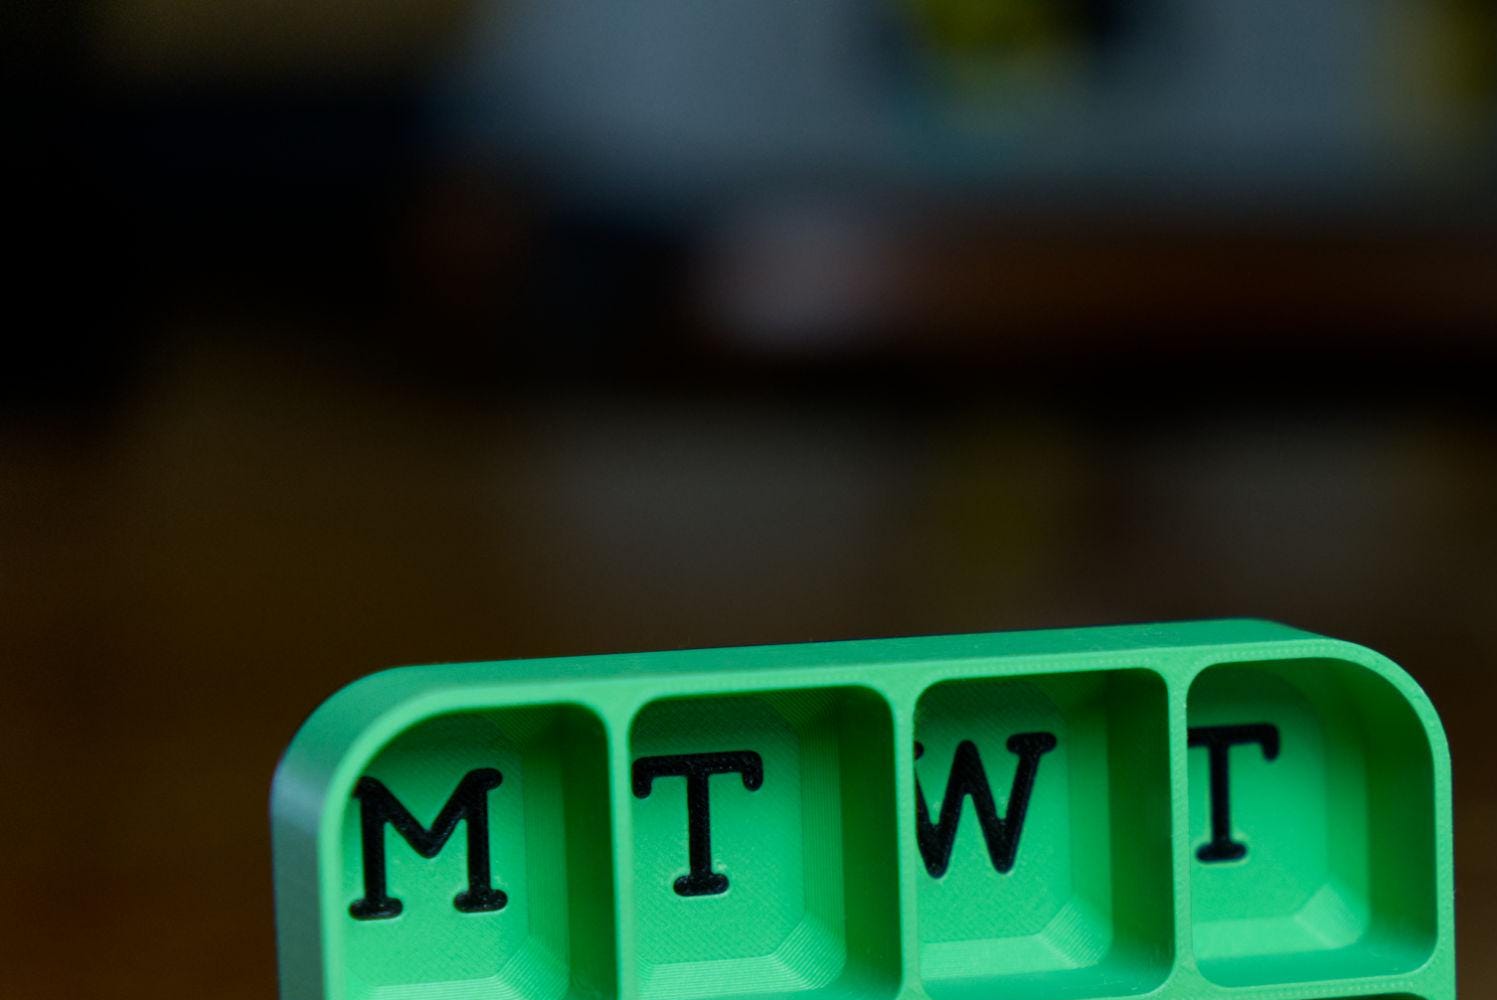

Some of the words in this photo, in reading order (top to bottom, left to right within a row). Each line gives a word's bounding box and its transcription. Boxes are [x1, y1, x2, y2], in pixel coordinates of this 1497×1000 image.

[350, 766, 508, 920] M
[631, 748, 764, 897] T
[914, 730, 1059, 878] W
[1187, 720, 1281, 862] T
